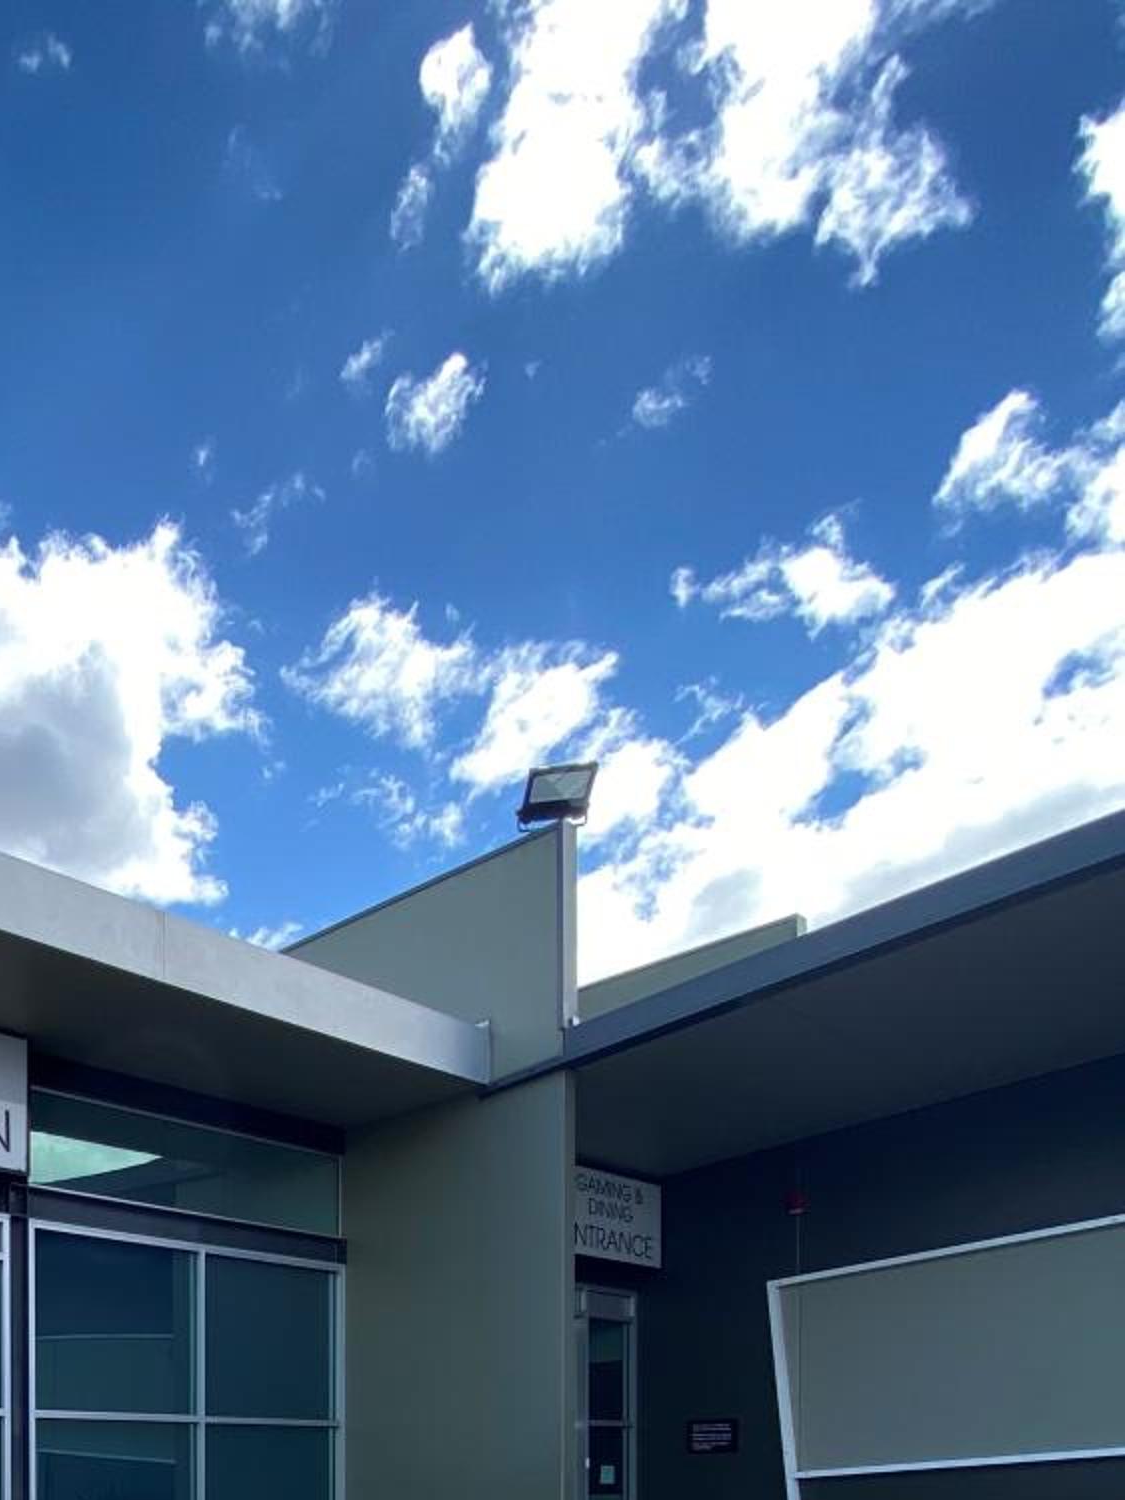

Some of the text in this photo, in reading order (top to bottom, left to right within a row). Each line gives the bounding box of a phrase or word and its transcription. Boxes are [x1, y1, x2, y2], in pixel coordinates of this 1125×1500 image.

[575, 1173, 632, 1203] GAMING
[588, 1197, 634, 1223] DINING
[574, 1221, 653, 1259] NTRANCE
